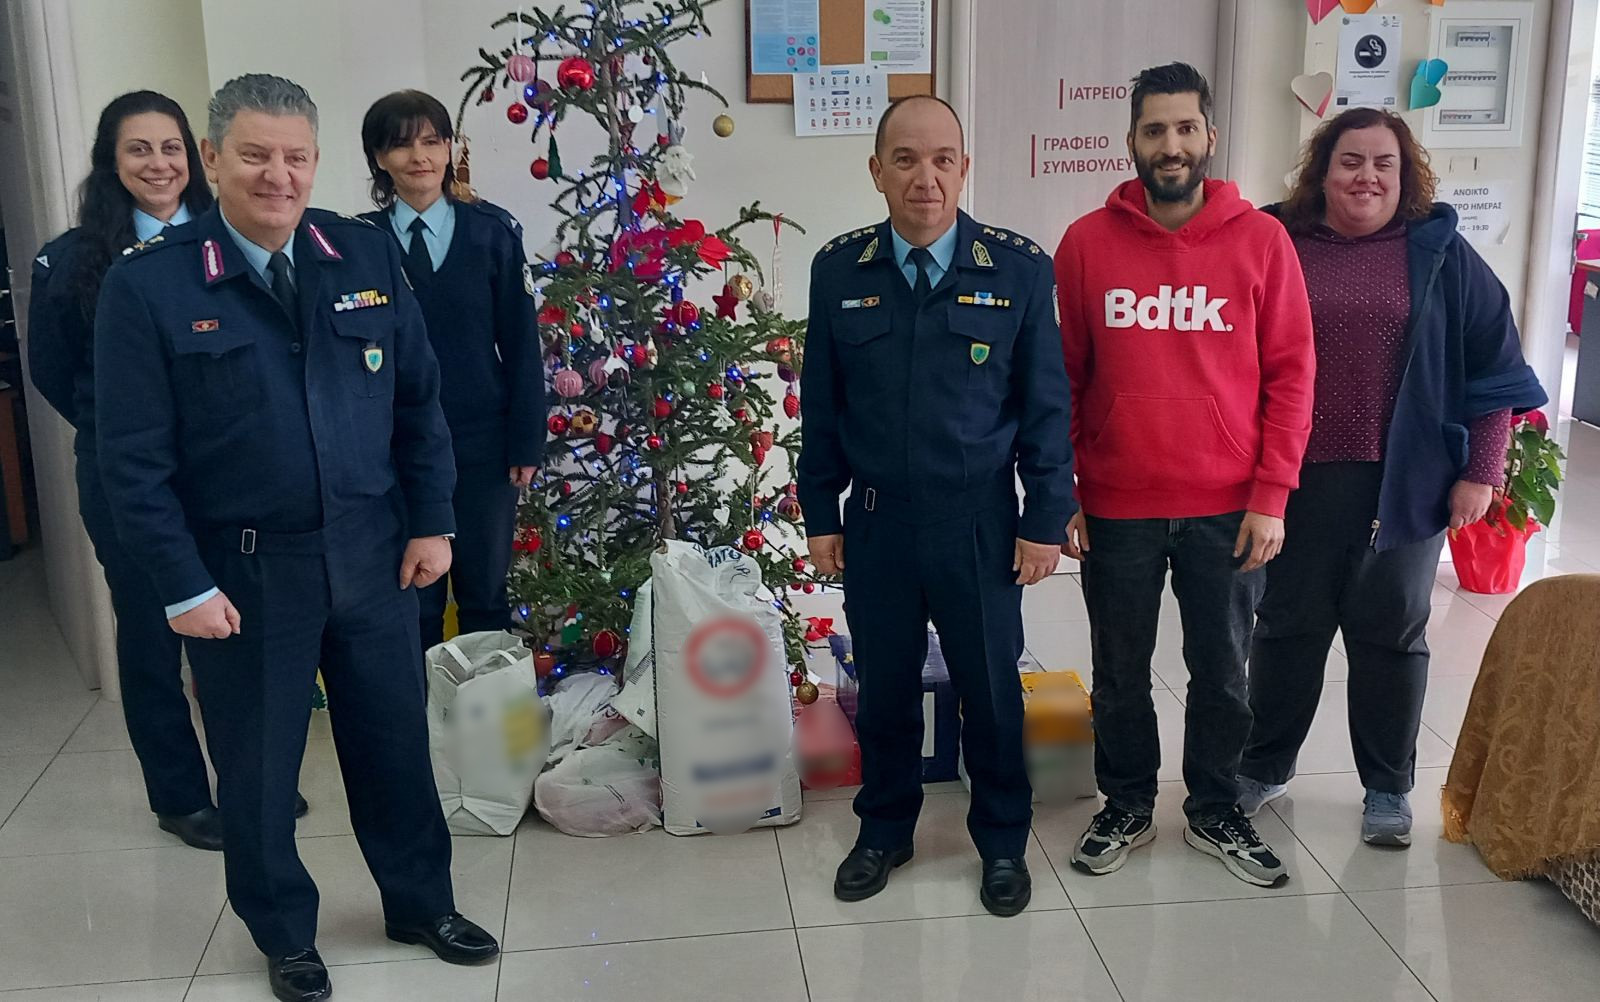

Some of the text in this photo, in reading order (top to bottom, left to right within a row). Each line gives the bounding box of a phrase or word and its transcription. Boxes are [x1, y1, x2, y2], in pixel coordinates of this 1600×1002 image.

[1069, 86, 1127, 101] ΙΑΤΡΕΙΟ
[1043, 135, 1109, 151] ΓΡΑΦΕΙΟ
[1453, 187, 1489, 196] ΑΝΟΙΚΤΟ
[1471, 202, 1502, 210] ΗΜΕΡΑΣ
